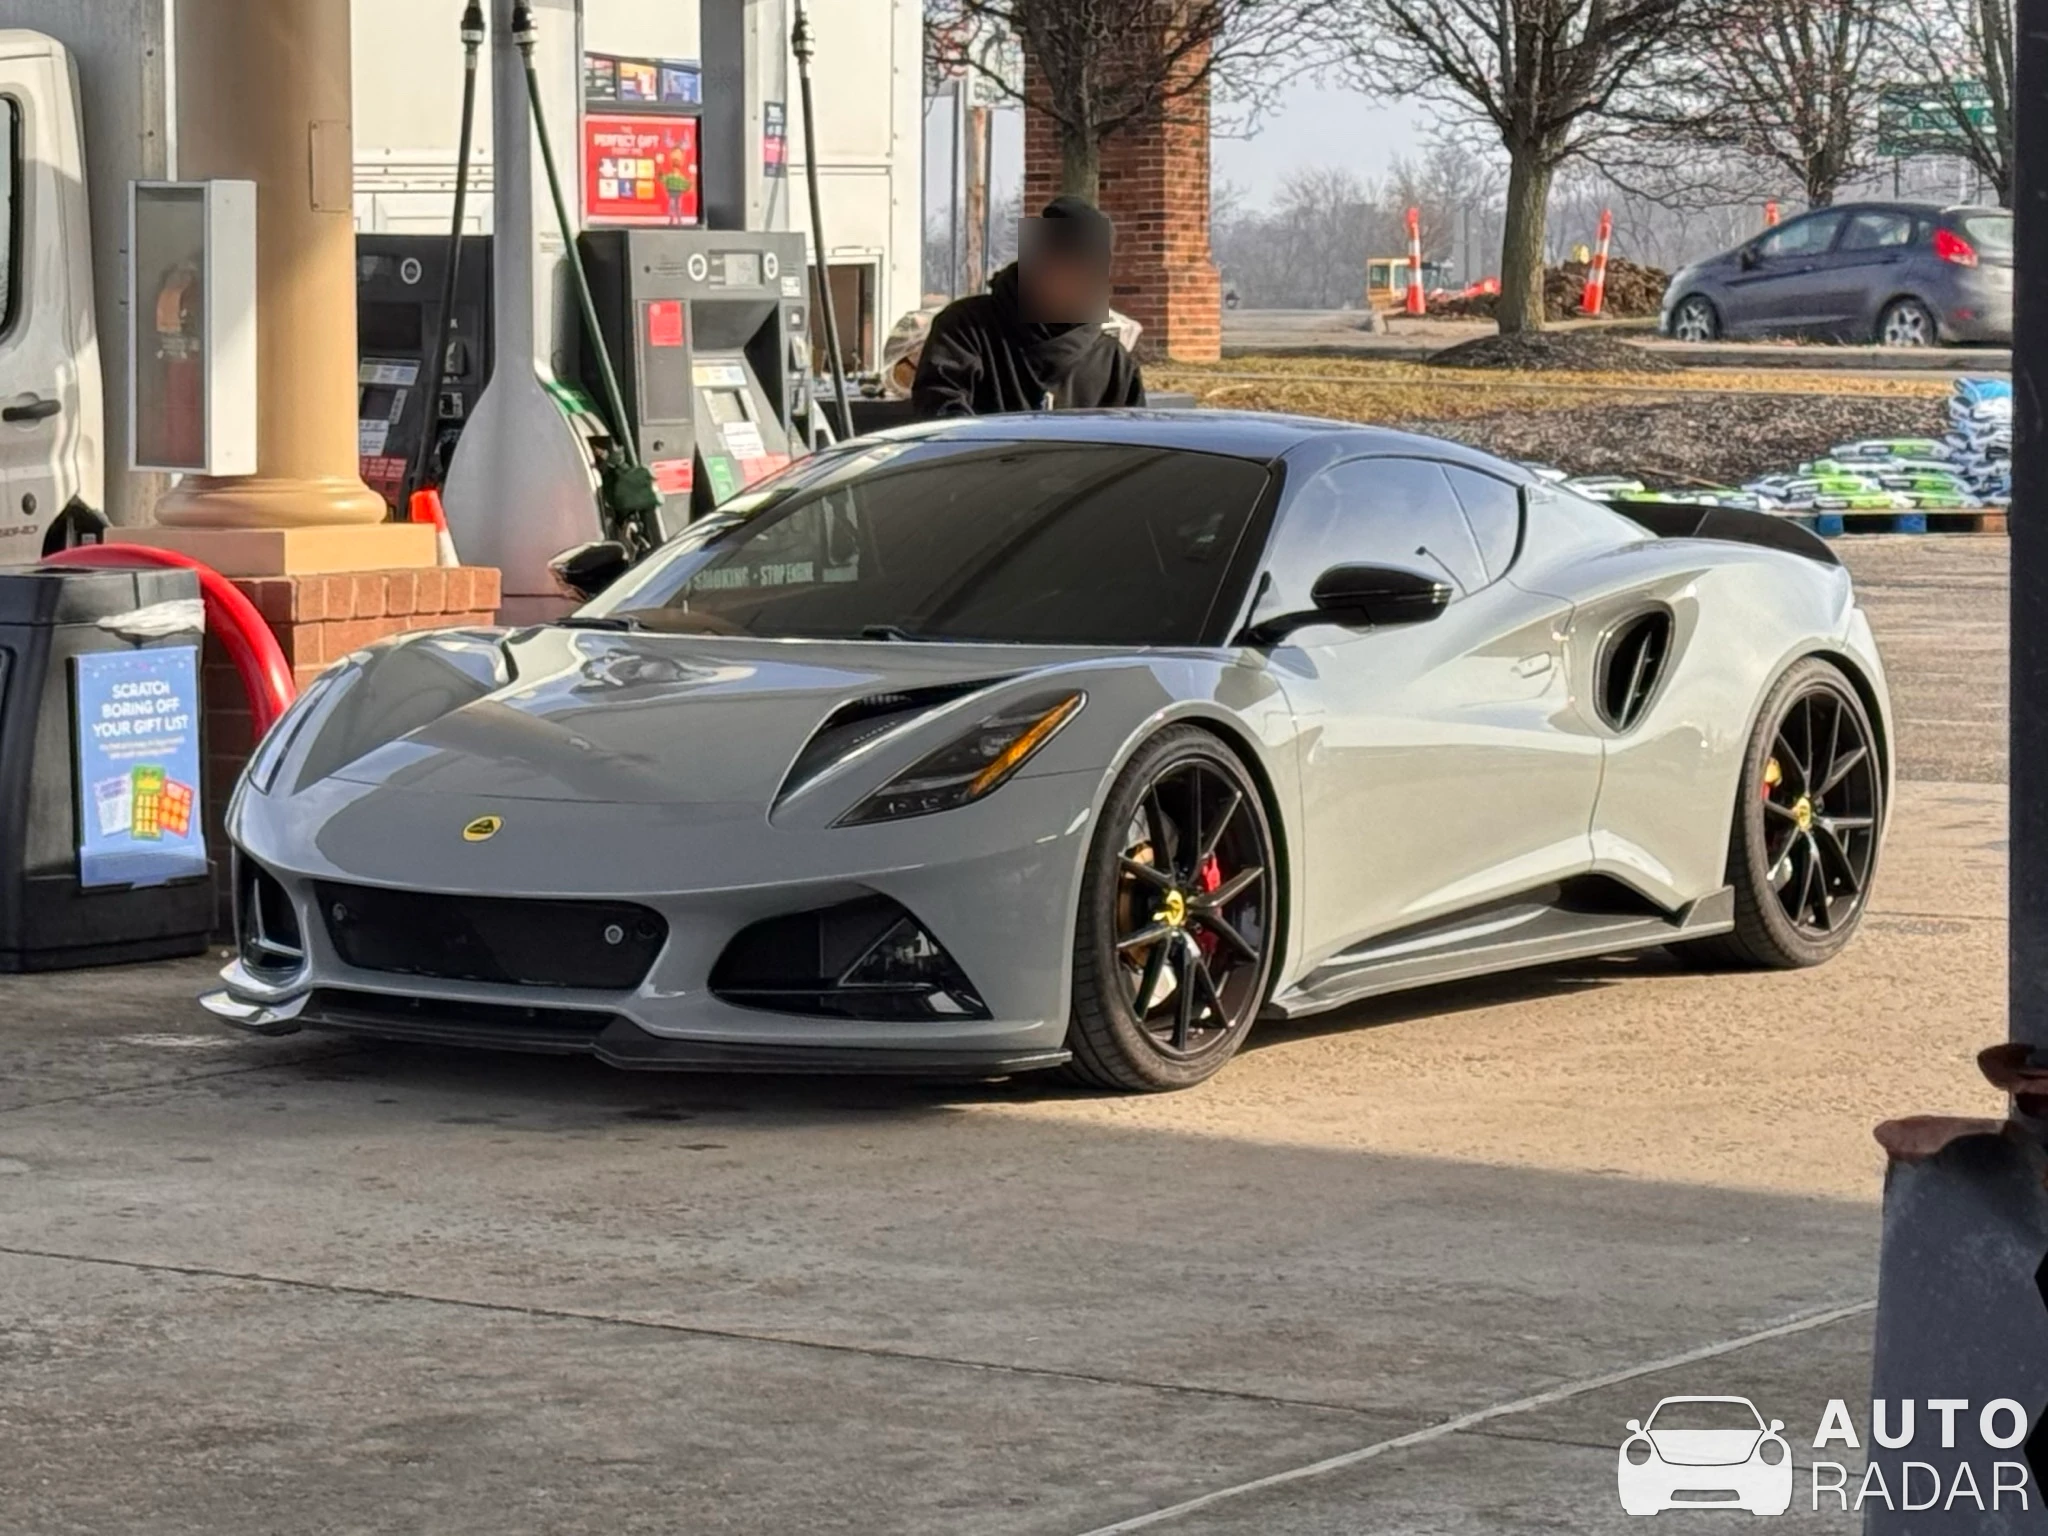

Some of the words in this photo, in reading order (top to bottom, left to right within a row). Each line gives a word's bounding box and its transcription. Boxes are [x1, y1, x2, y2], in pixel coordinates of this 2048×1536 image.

[112, 681, 170, 699] SCRATCH
[102, 700, 153, 718] BORING
[156, 697, 180, 714] OFF
[92, 720, 131, 738] YOUR
[133, 717, 162, 735] GIFT
[164, 714, 189, 732] LIST
